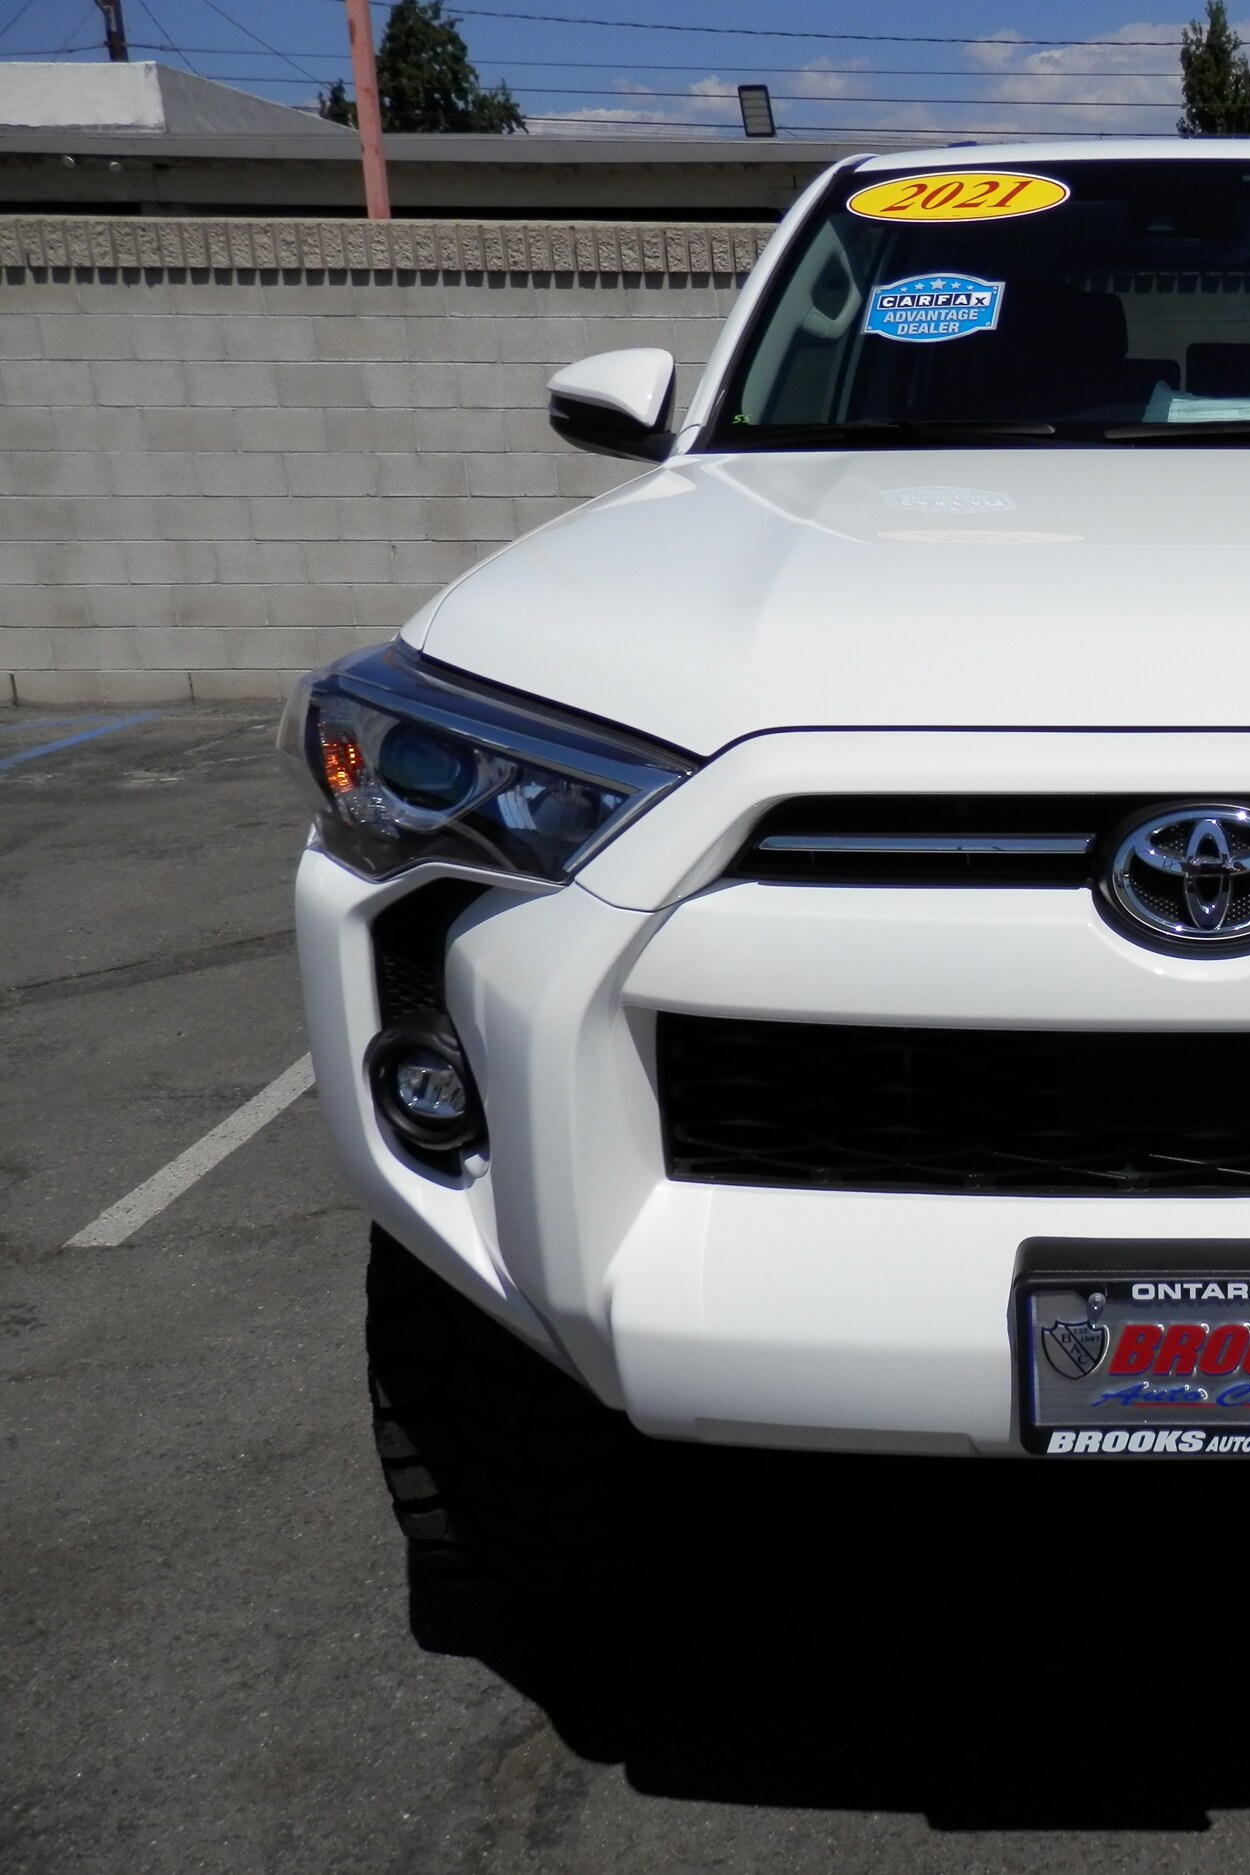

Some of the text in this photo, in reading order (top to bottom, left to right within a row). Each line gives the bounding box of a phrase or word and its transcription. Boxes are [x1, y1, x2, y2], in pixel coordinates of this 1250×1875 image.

[880, 180, 1033, 212] 2021
[880, 294, 989, 309] CARFAX
[883, 309, 979, 323] ADVANTAGE
[896, 322, 960, 335] DEALER
[1091, 1381, 1208, 1406] Auto
[1046, 1430, 1206, 1454] BROOKS
